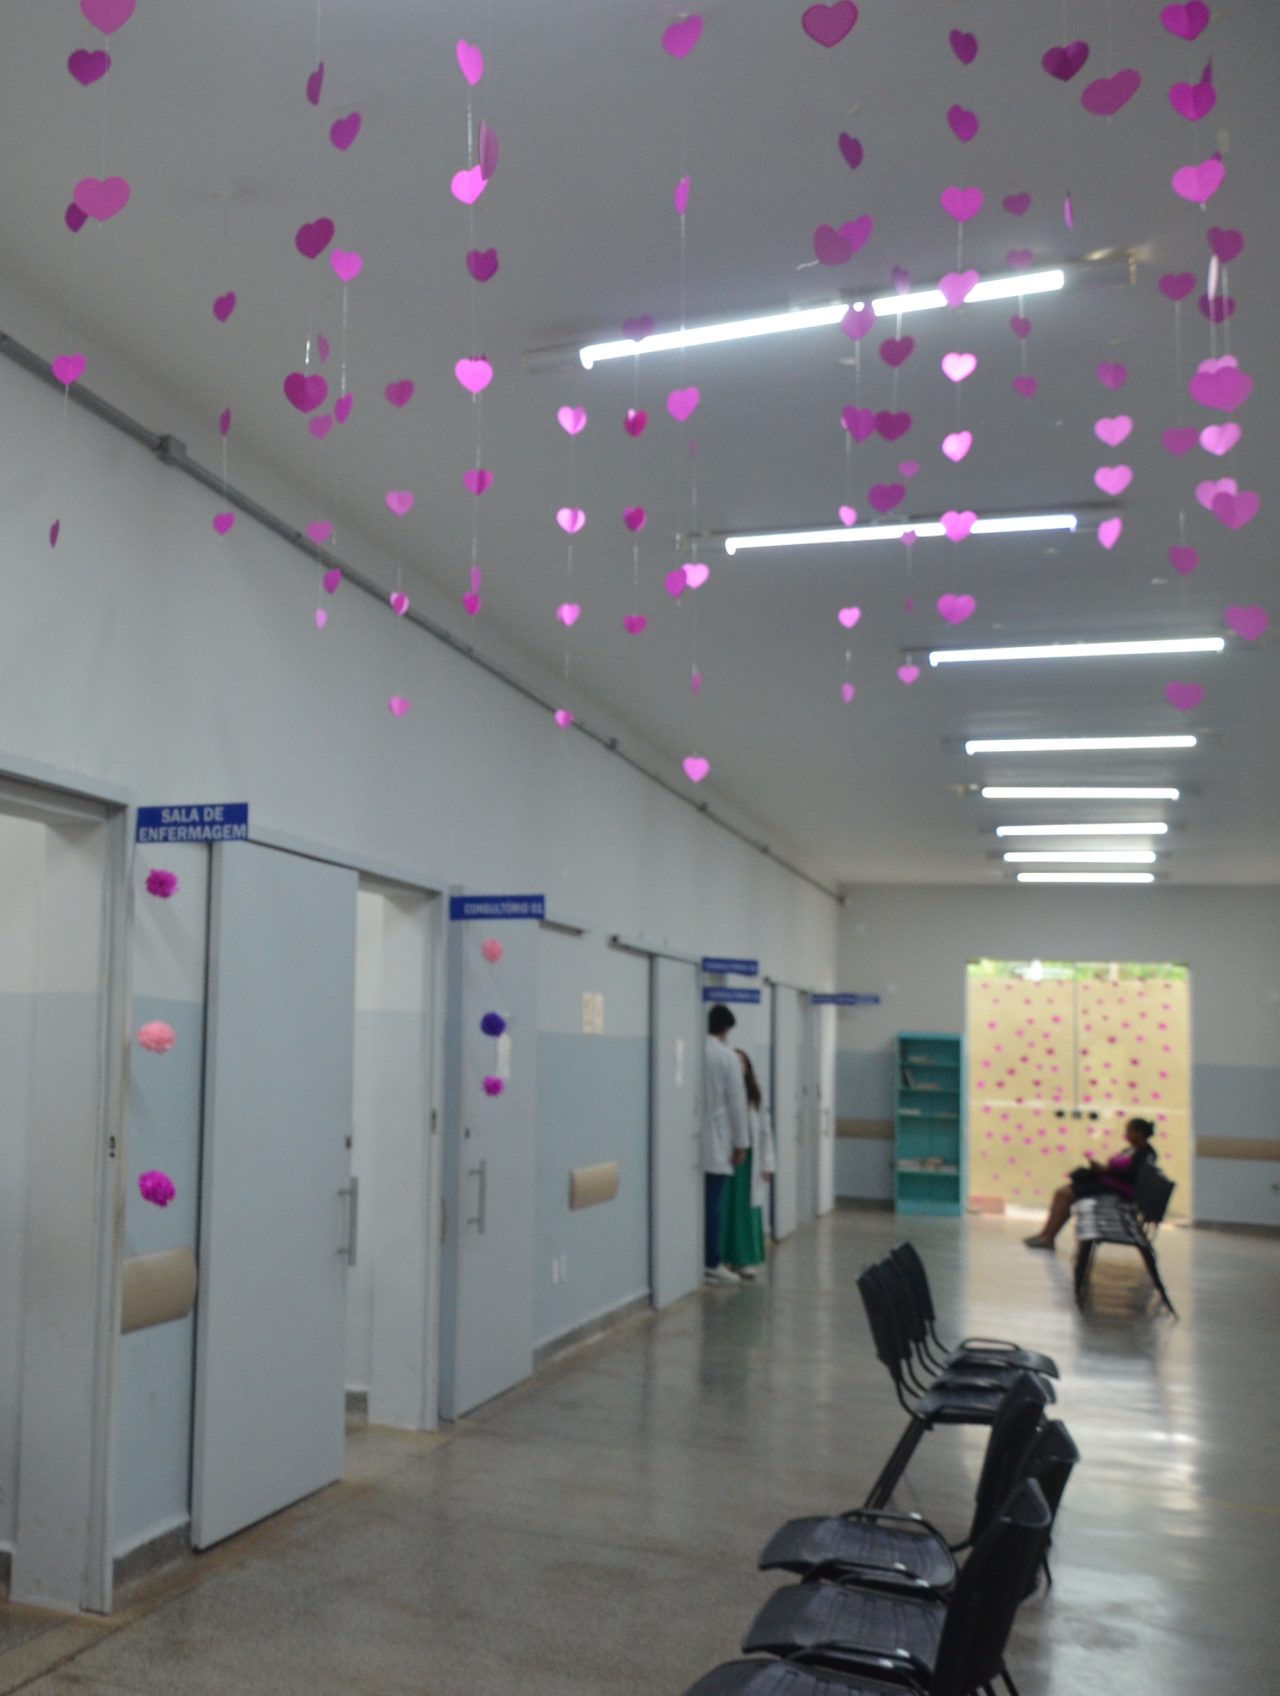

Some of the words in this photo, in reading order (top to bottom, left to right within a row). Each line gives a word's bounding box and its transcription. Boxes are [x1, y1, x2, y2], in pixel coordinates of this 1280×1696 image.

[161, 808, 199, 823] SALA
[203, 806, 224, 821] DE
[138, 824, 246, 841] ENFERMAGEM
